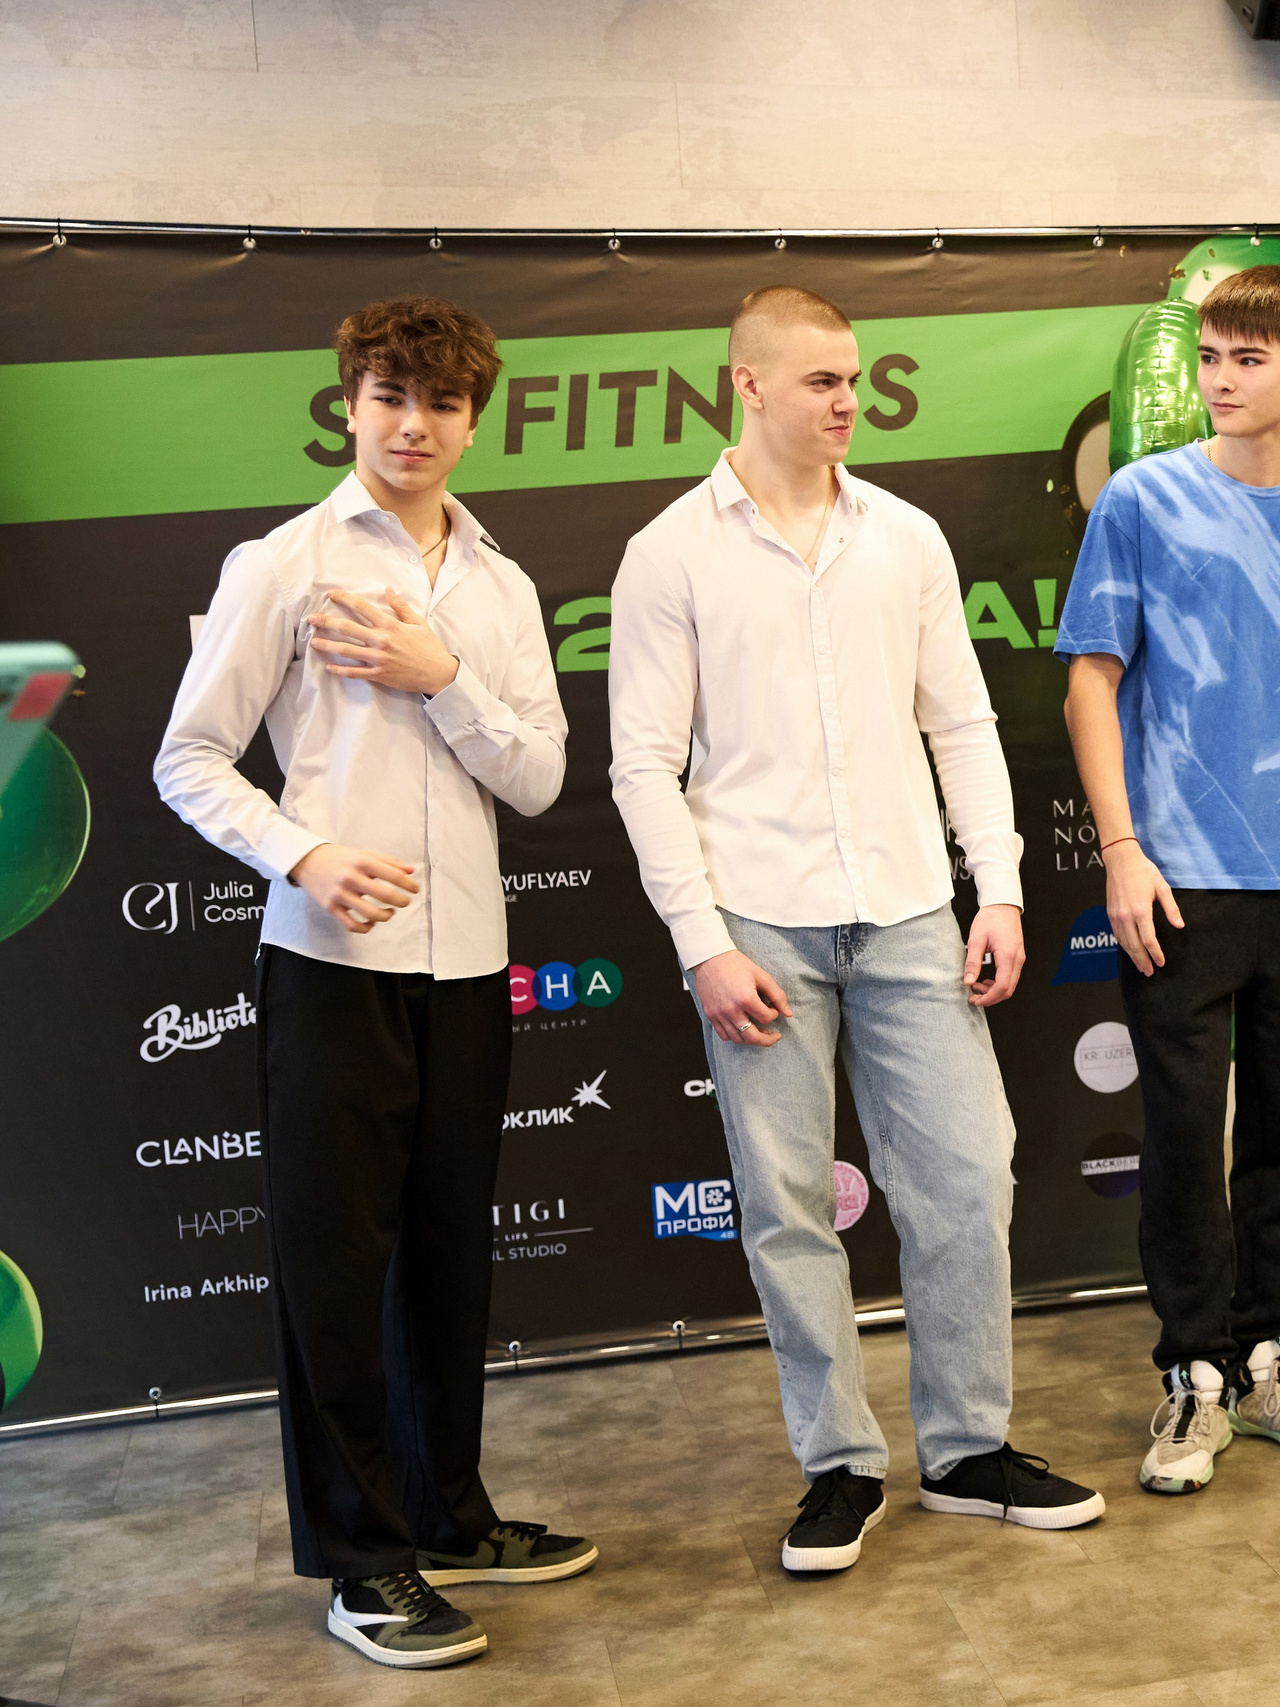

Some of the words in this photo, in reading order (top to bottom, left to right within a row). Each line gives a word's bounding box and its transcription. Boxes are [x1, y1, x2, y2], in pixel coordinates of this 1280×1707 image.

[503, 354, 921, 455] FITNS
[1056, 850, 1104, 871] LIA
[203, 880, 254, 901] Julia
[657, 1213, 734, 1236] ПРОФИ
[508, 1242, 568, 1260] STUDIO
[144, 1283, 192, 1303] Irina
[200, 1273, 270, 1297] Arkhip
